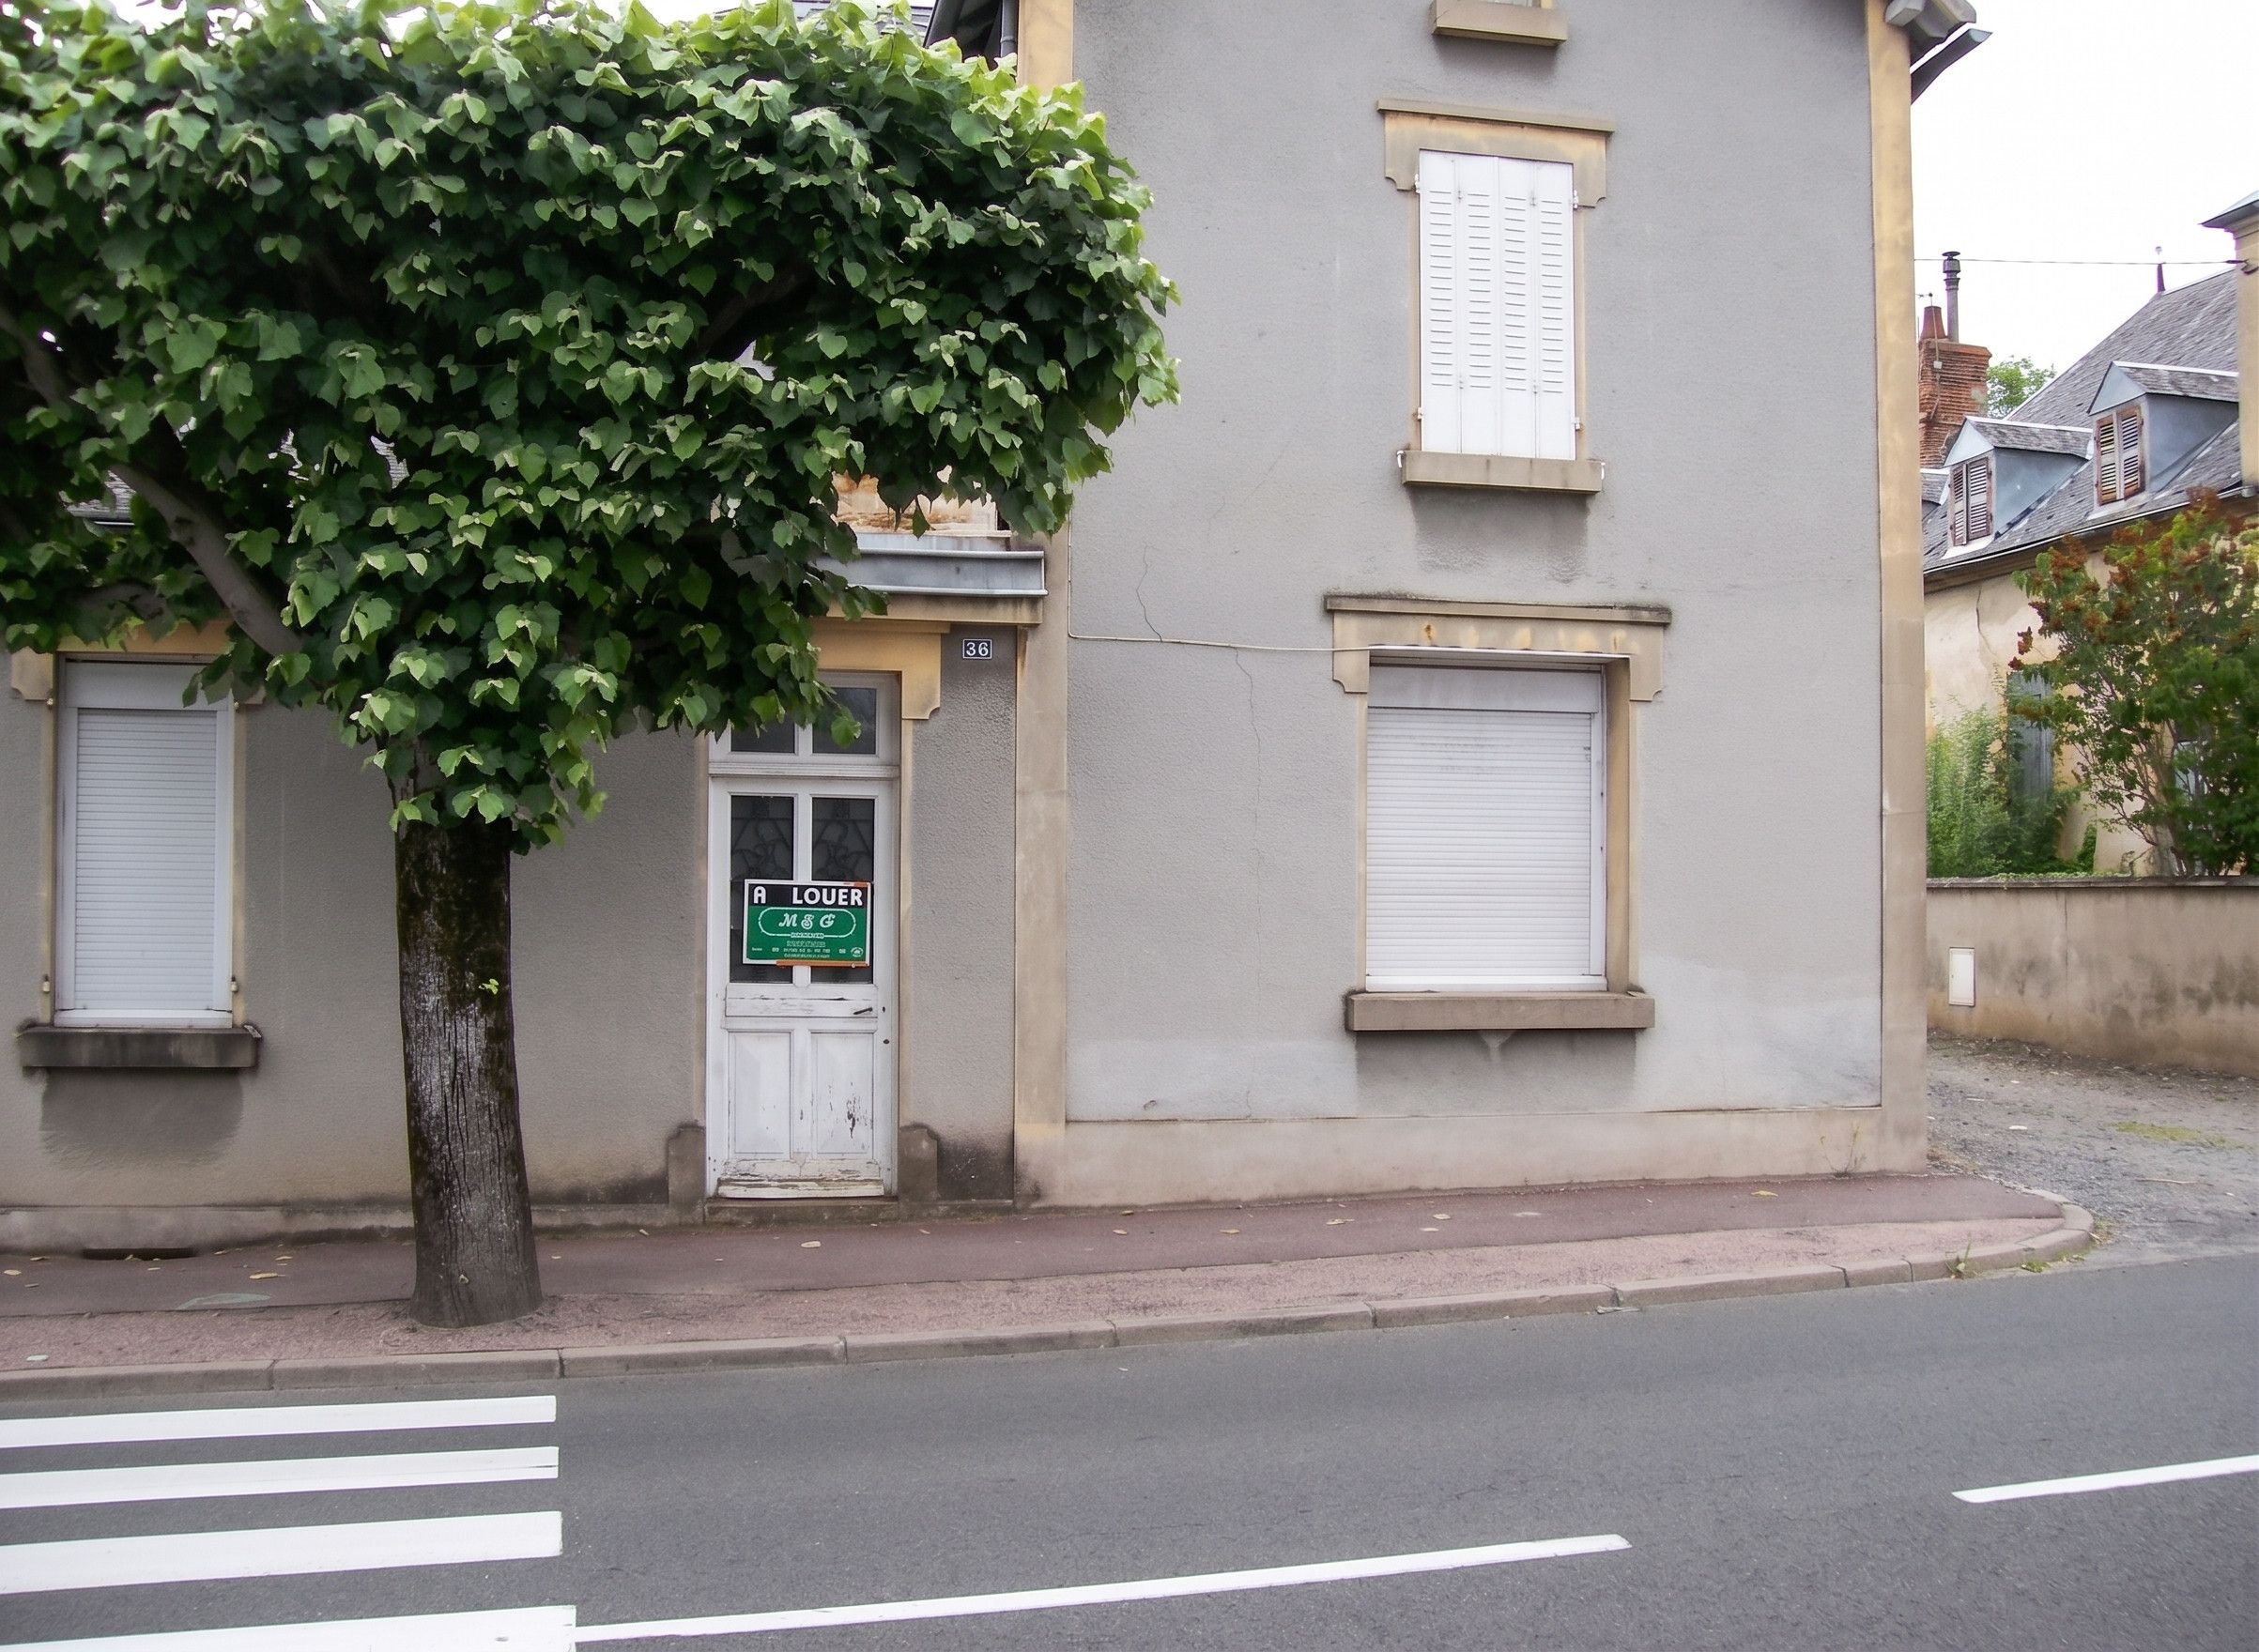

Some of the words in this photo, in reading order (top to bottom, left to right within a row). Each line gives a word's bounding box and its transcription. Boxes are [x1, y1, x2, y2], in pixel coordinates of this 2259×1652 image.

[966, 642, 989, 656] 36
[753, 885, 766, 904] A
[792, 887, 863, 906] LOUER
